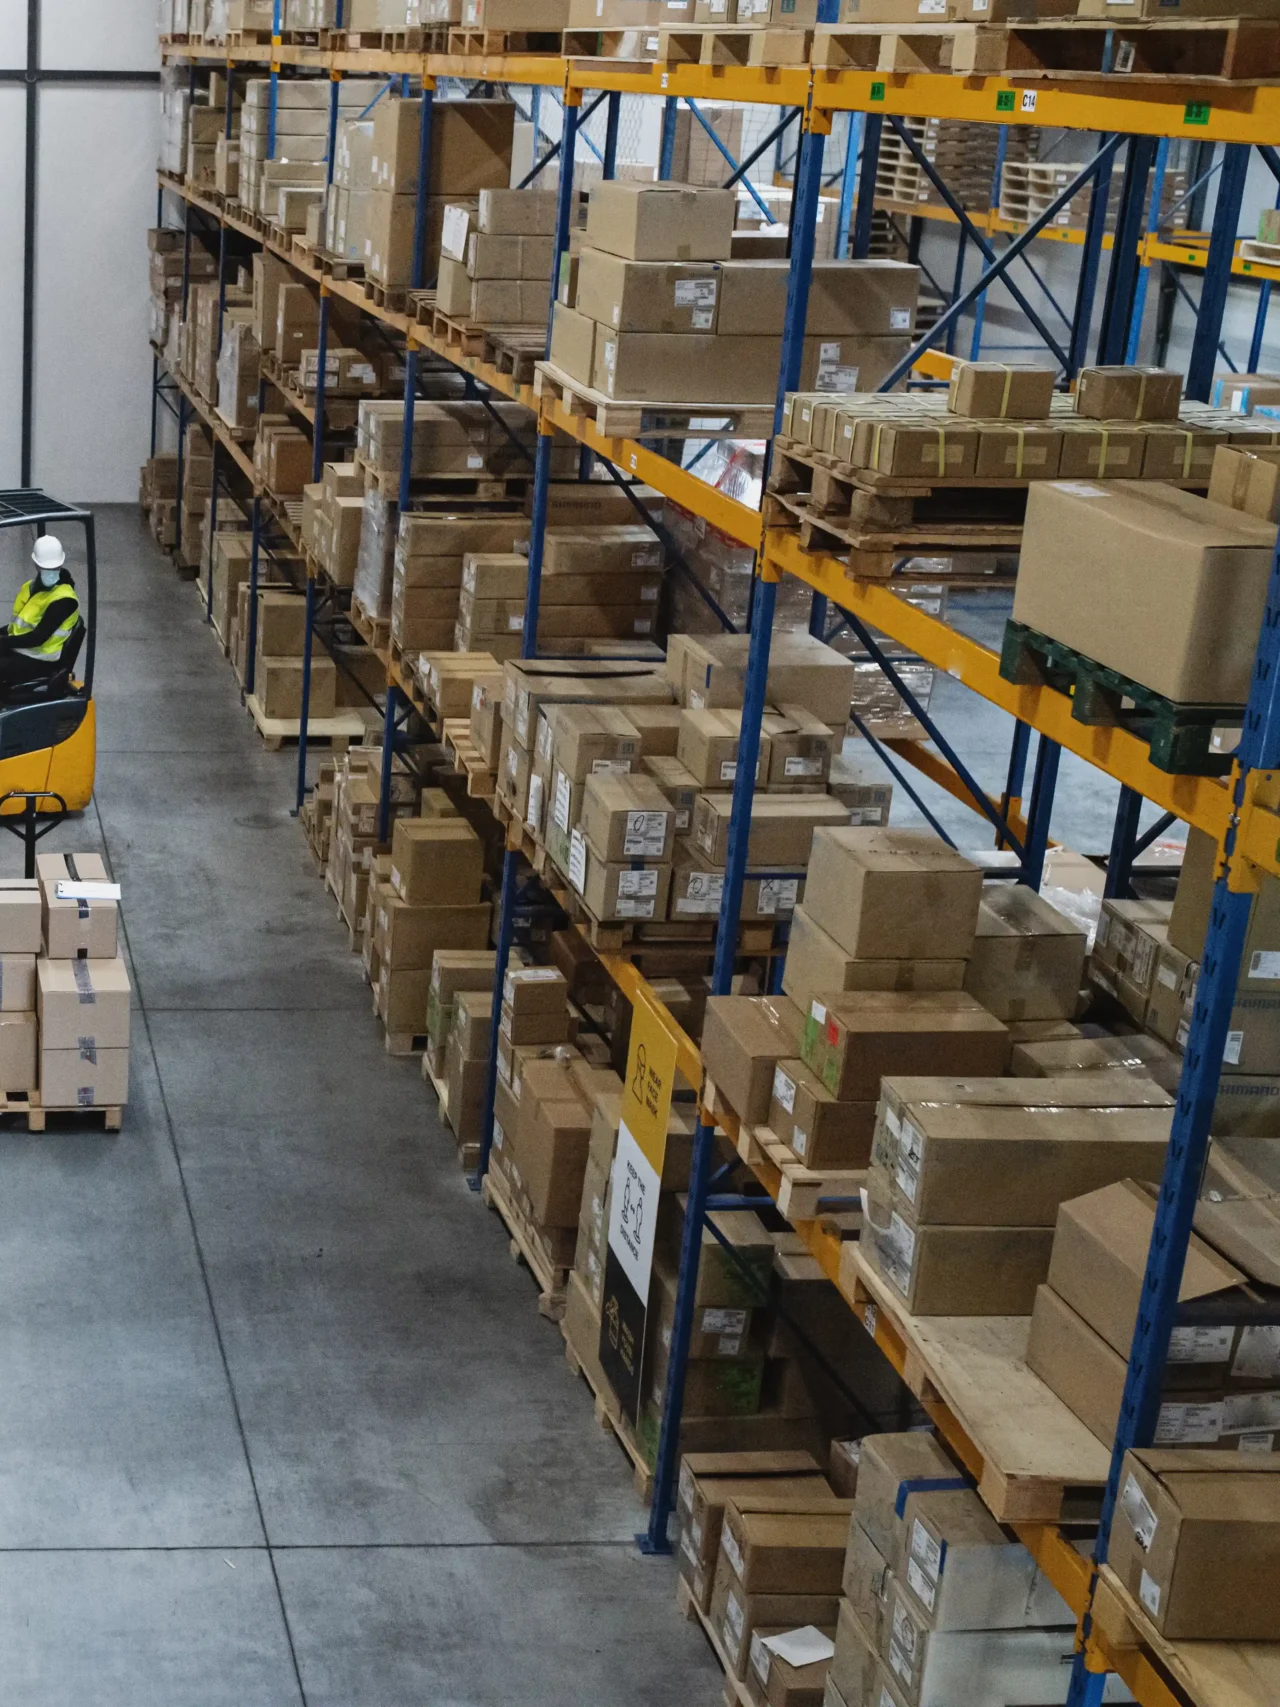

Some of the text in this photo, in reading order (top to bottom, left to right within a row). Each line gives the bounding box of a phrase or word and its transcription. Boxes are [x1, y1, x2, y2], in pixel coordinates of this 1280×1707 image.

[1022, 94, 1036, 107] C14
[648, 1066, 662, 1089] WEAR
[647, 1081, 659, 1103] FACE
[626, 1160, 646, 1196] KEEP THE
[620, 1225, 639, 1261] DISTANCE
